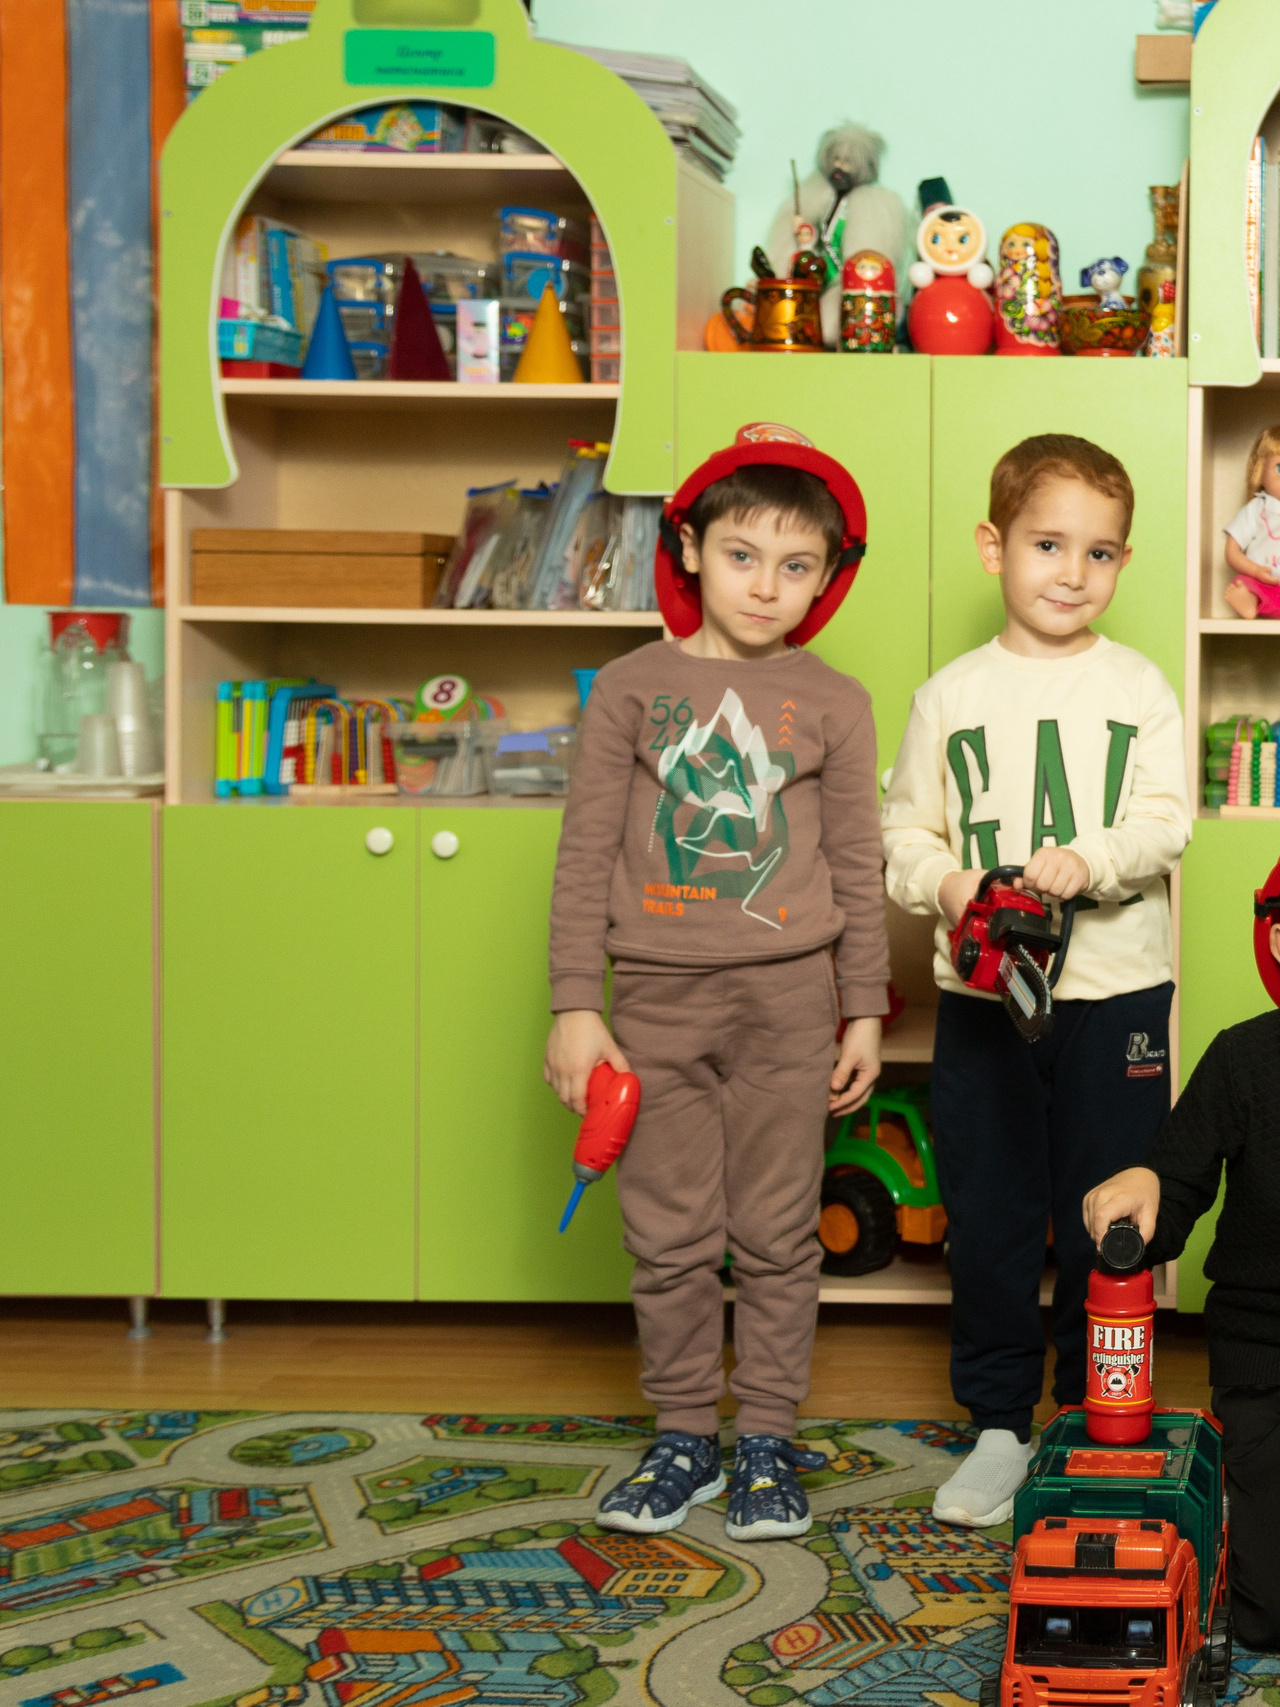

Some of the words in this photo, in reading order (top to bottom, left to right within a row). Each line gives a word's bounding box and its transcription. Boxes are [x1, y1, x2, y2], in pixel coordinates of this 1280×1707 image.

[433, 680, 455, 703] 8
[650, 695, 694, 726] 56
[644, 882, 718, 900] MOUNTAIN
[642, 899, 685, 917] TRAILS
[1092, 1323, 1146, 1351] FIRE
[1092, 1351, 1146, 1367] extinguisher
[785, 1630, 808, 1650] H
